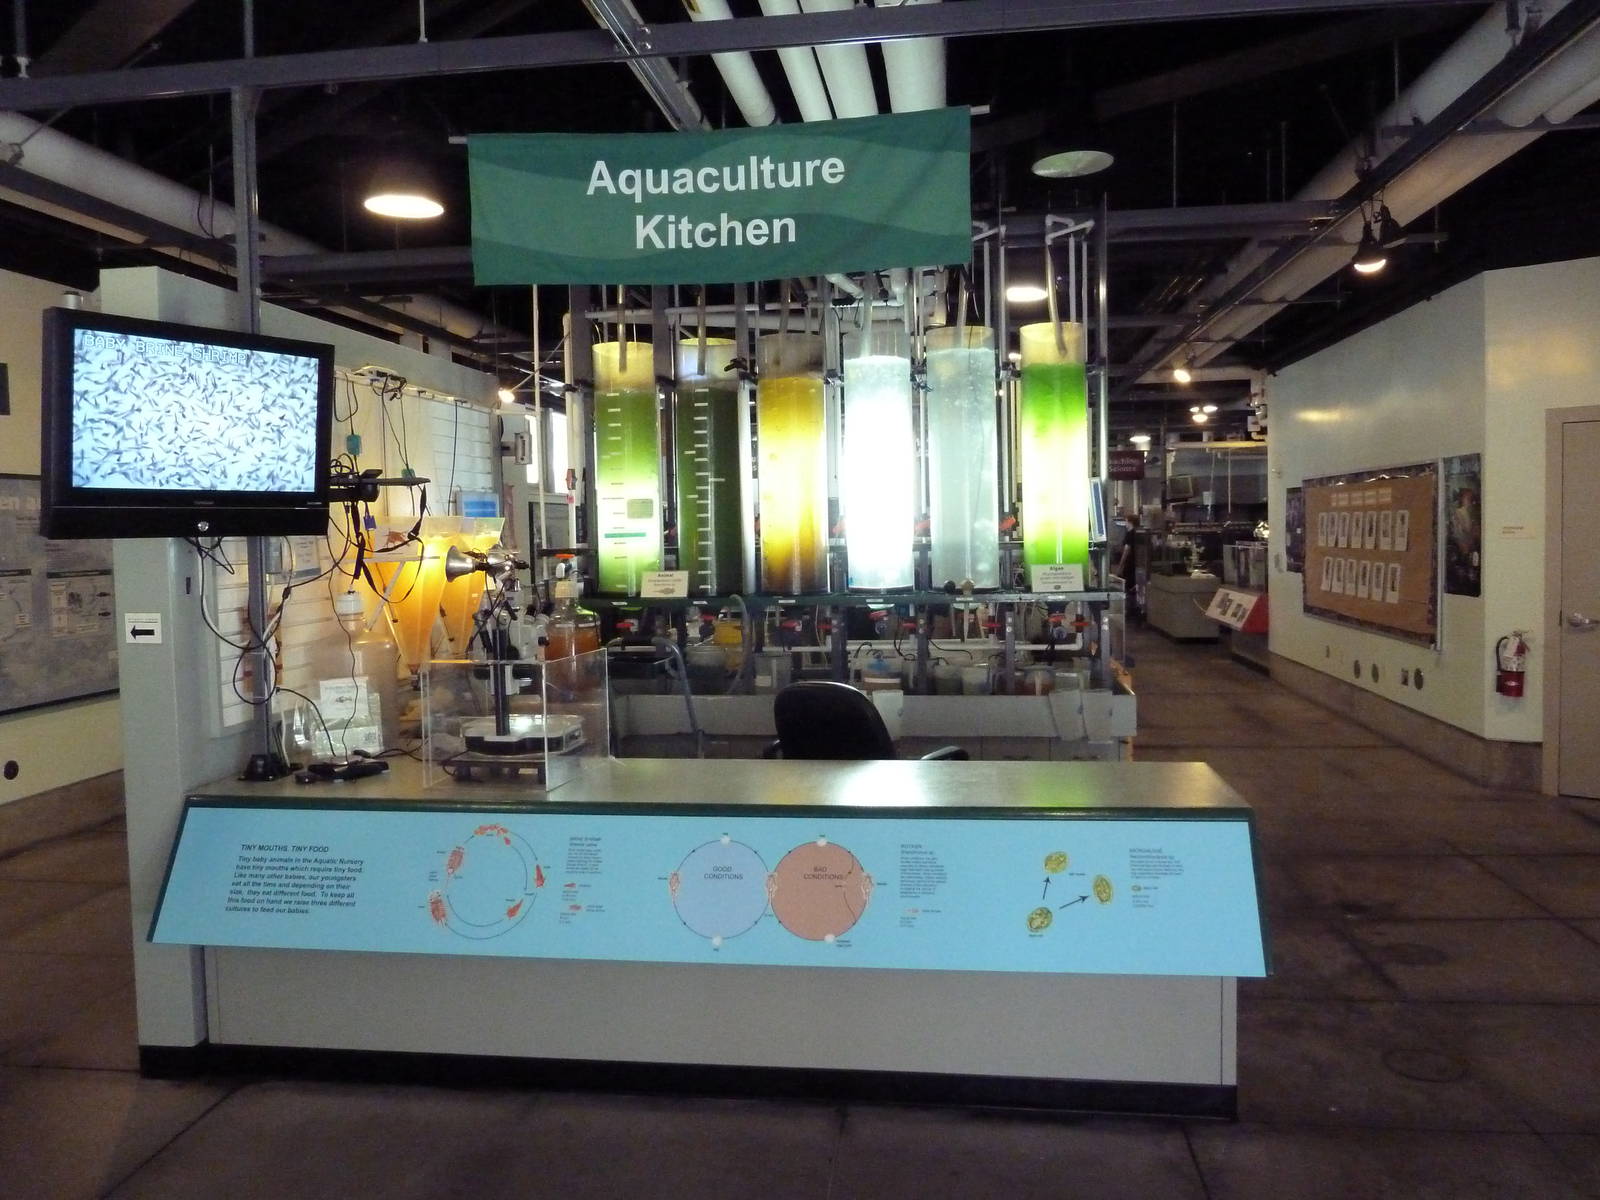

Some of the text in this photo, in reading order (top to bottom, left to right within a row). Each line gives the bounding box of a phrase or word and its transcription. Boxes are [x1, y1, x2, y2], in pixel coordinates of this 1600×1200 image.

[586, 154, 846, 203] Aquaculture
[635, 212, 796, 250] Kitchen
[84, 335, 246, 363] BABY BRINE SHRIMP
[308, 845, 329, 853] FOOD
[239, 855, 252, 863] Tiny
[252, 856, 267, 864] baby
[338, 858, 364, 866] Nursery
[320, 874, 356, 882] youngsters
[703, 872, 744, 880] CONDITIONS
[803, 872, 844, 881] CONDITIONS
[291, 882, 325, 890] depending
[329, 891, 346, 899] keep
[328, 899, 356, 907] different
